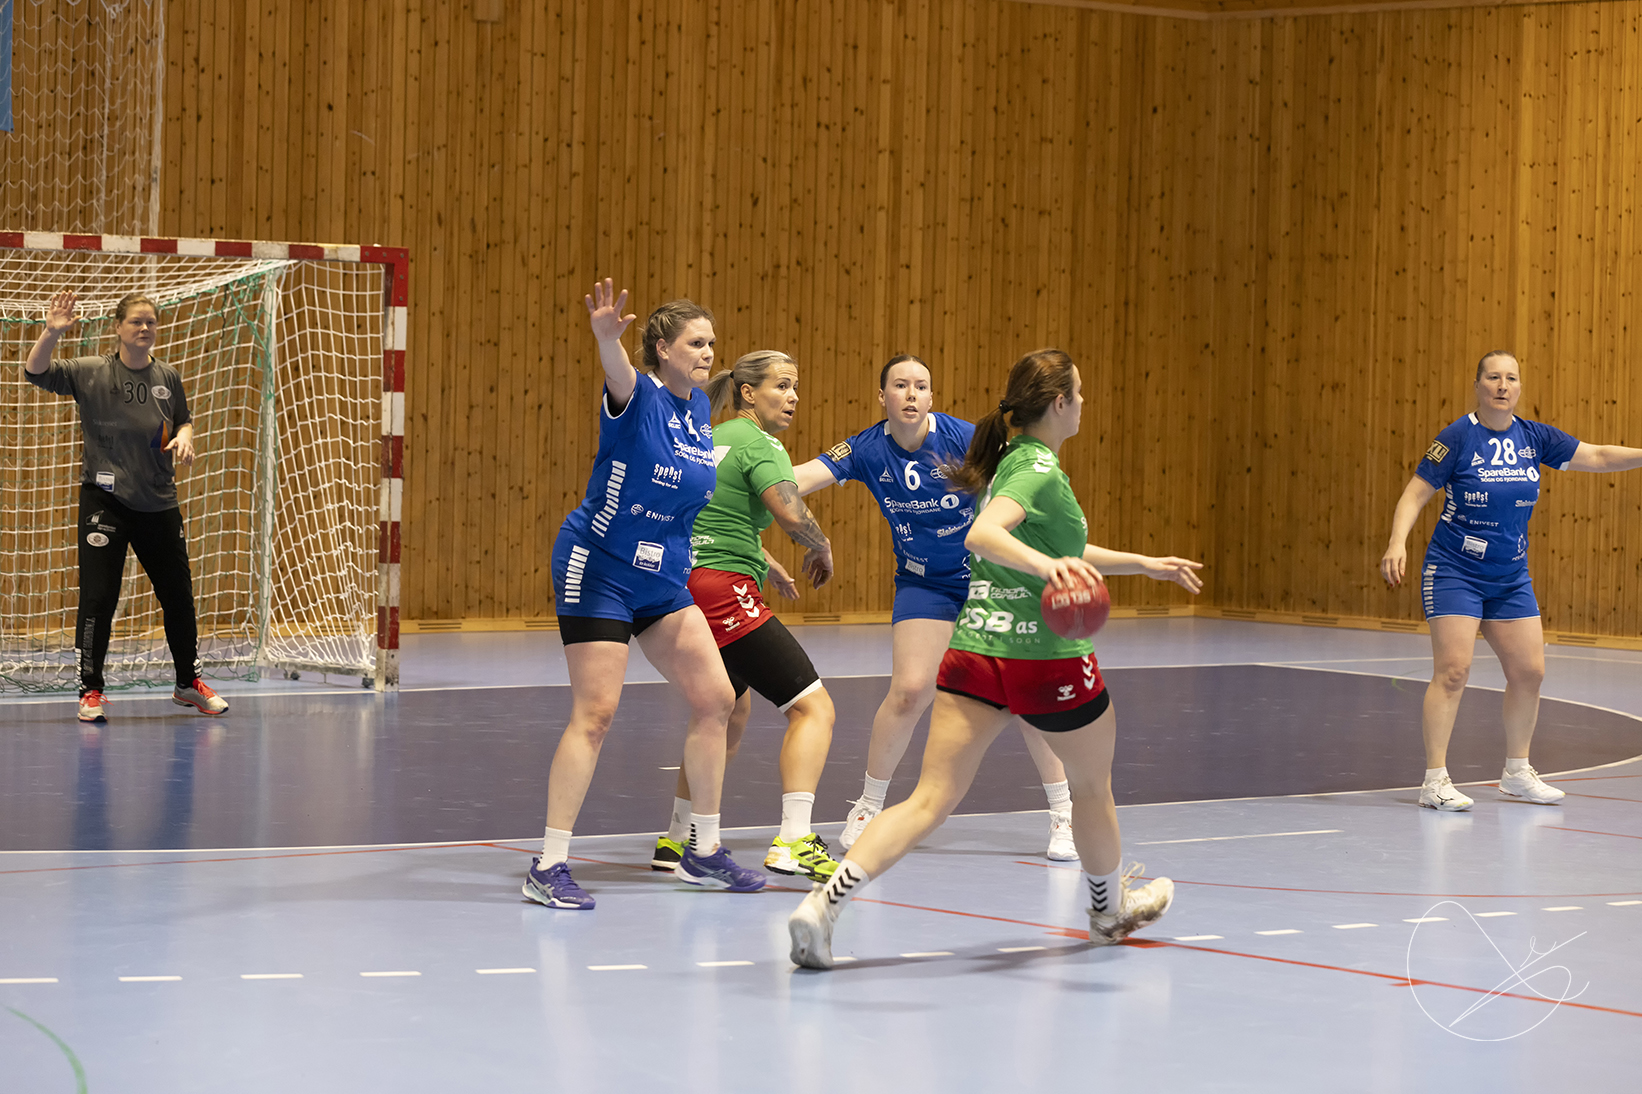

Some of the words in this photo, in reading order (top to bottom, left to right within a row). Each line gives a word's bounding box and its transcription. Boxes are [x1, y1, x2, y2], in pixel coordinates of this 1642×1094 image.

[124, 381, 148, 404] 30
[1488, 437, 1518, 466] 28
[904, 460, 920, 490] 6
[1477, 467, 1527, 478] SpareBank
[884, 496, 939, 510] SpareBank
[1469, 519, 1499, 527] ENIVEST
[639, 547, 661, 558] Bistro
[1016, 621, 1038, 634] as
